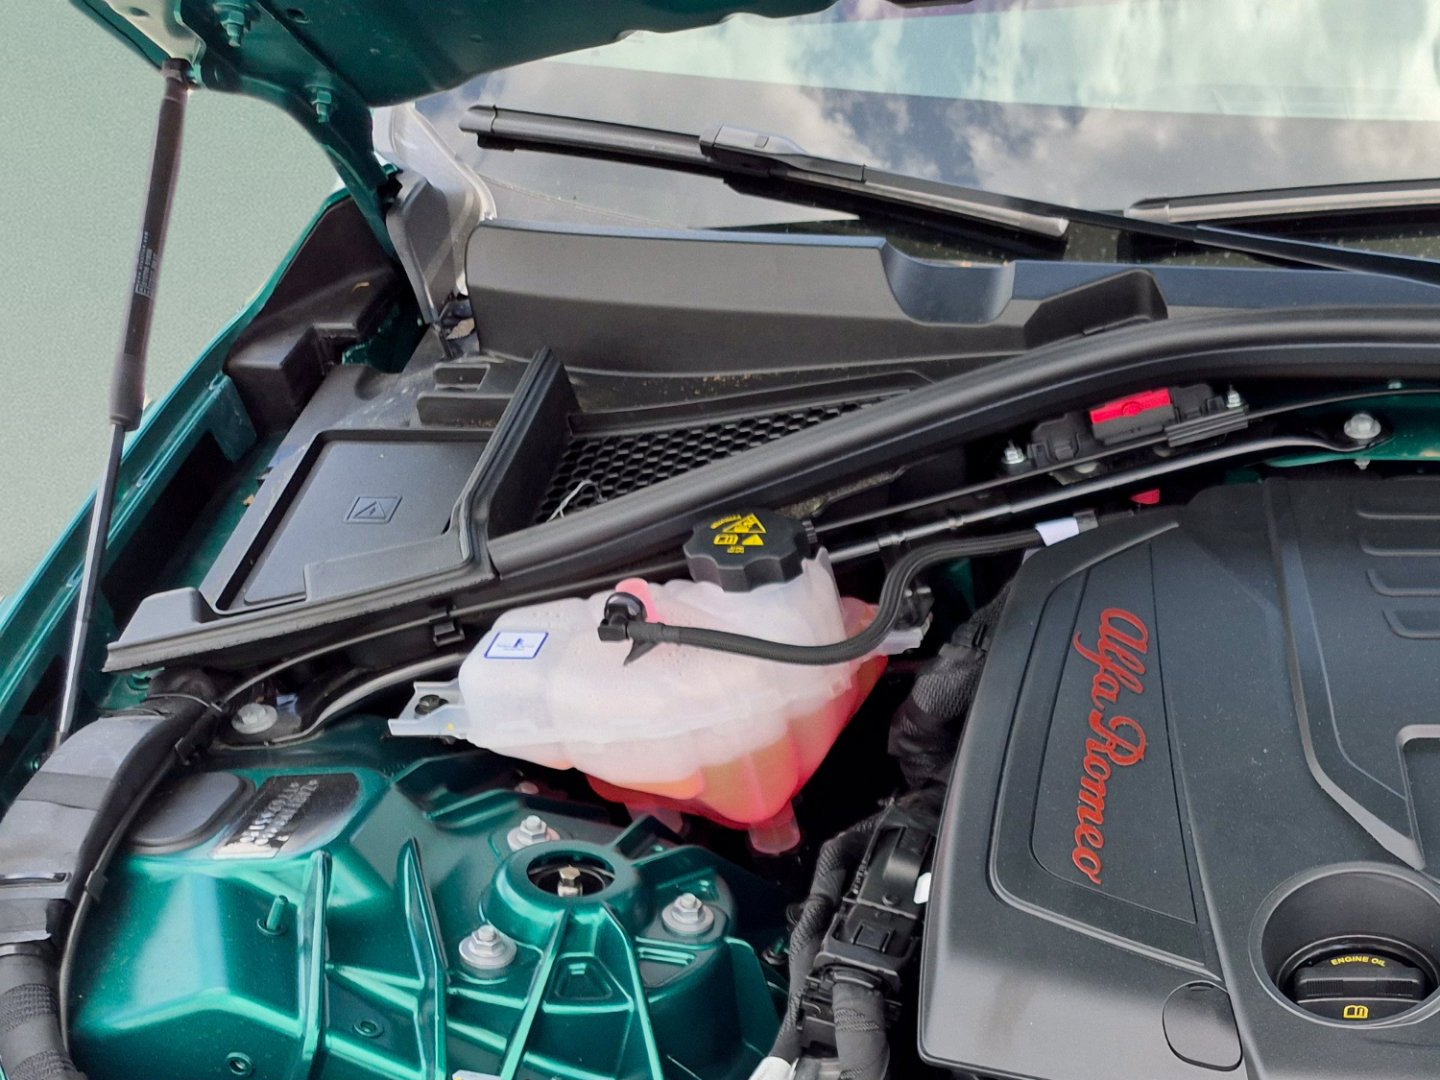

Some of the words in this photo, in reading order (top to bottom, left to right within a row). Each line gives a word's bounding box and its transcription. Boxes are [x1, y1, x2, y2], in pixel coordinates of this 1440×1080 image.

[1073, 607, 1149, 711] Alfa
[1071, 708, 1148, 885] Romeo
[1330, 955, 1369, 966] ENGINE
[1371, 957, 1386, 967] OIL
